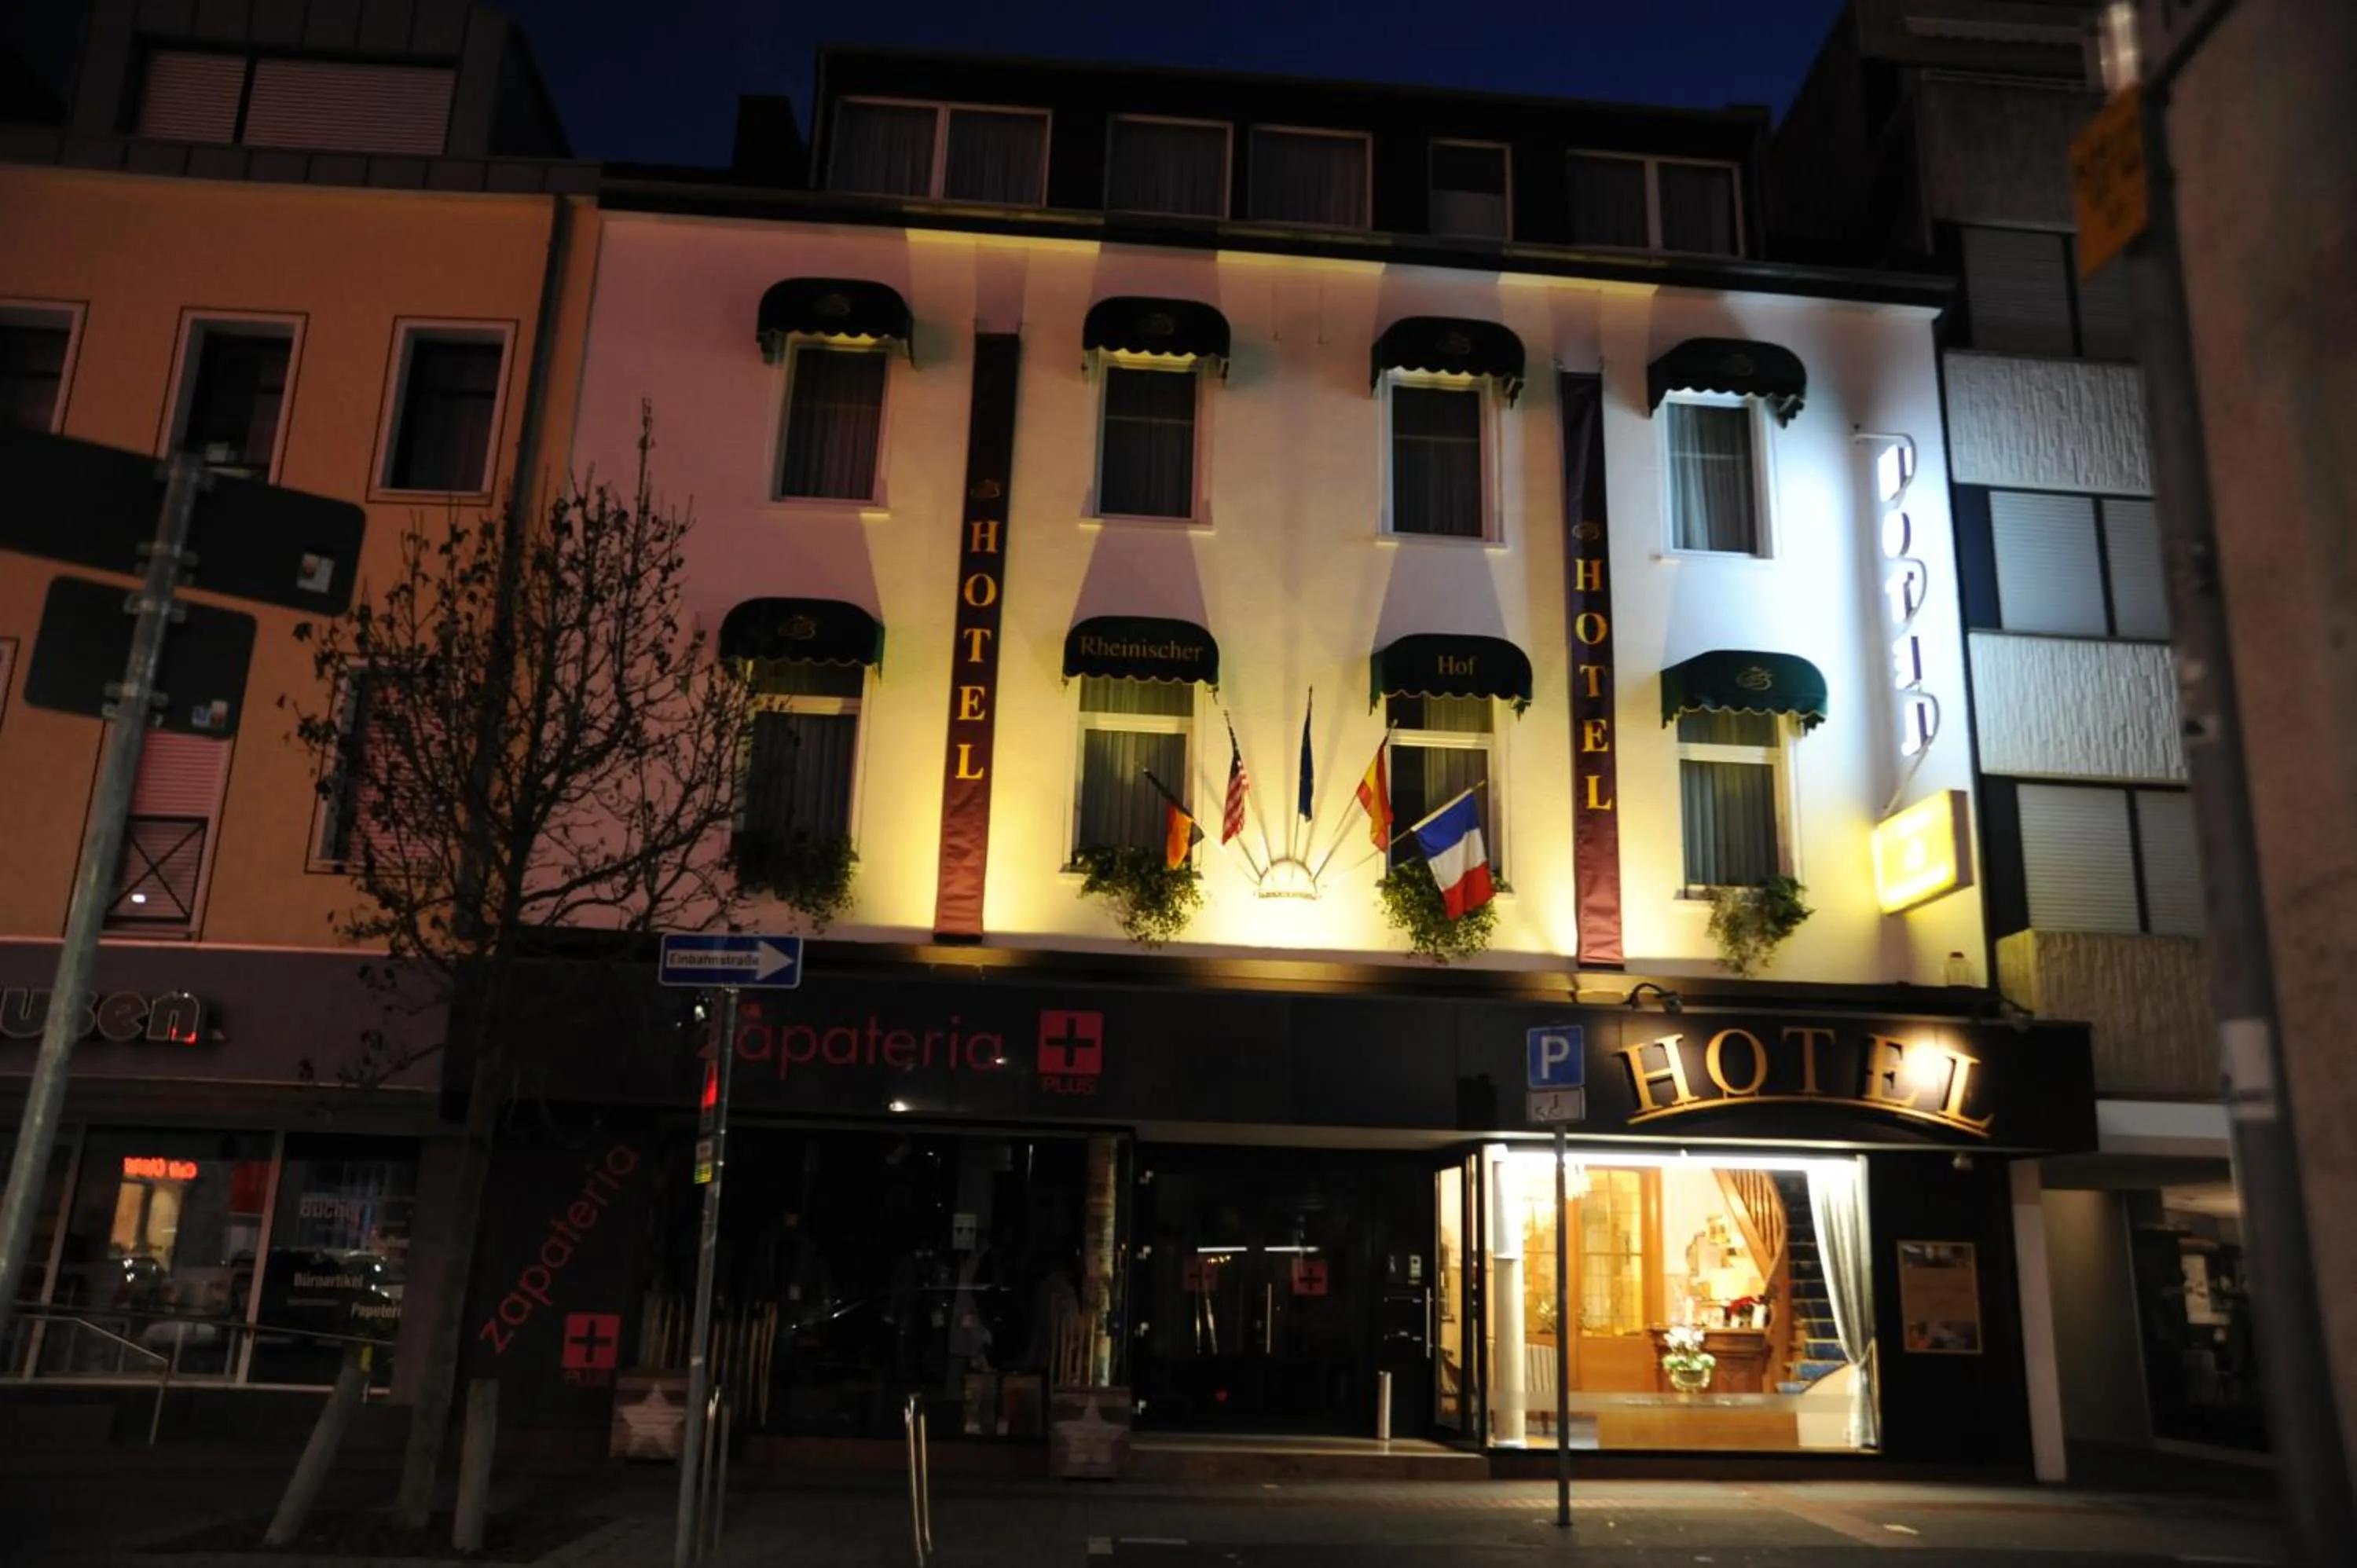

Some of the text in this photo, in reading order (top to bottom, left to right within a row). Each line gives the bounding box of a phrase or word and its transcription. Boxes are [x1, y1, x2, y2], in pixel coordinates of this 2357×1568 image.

[955, 520, 999, 781] HOTEL
[1080, 635, 1204, 662] Rheinischer
[1436, 653, 1479, 676] Hof
[1574, 557, 1612, 811] HOTEL
[669, 952, 759, 966] Einbahnstraße
[696, 1013, 1006, 1081] apateria
[1541, 1035, 1571, 1080] P
[1042, 1075, 1096, 1095] PLUS
[1616, 1027, 1996, 1129] HOTEL
[300, 1193, 359, 1218] Büche
[478, 1144, 640, 1357] zapateria
